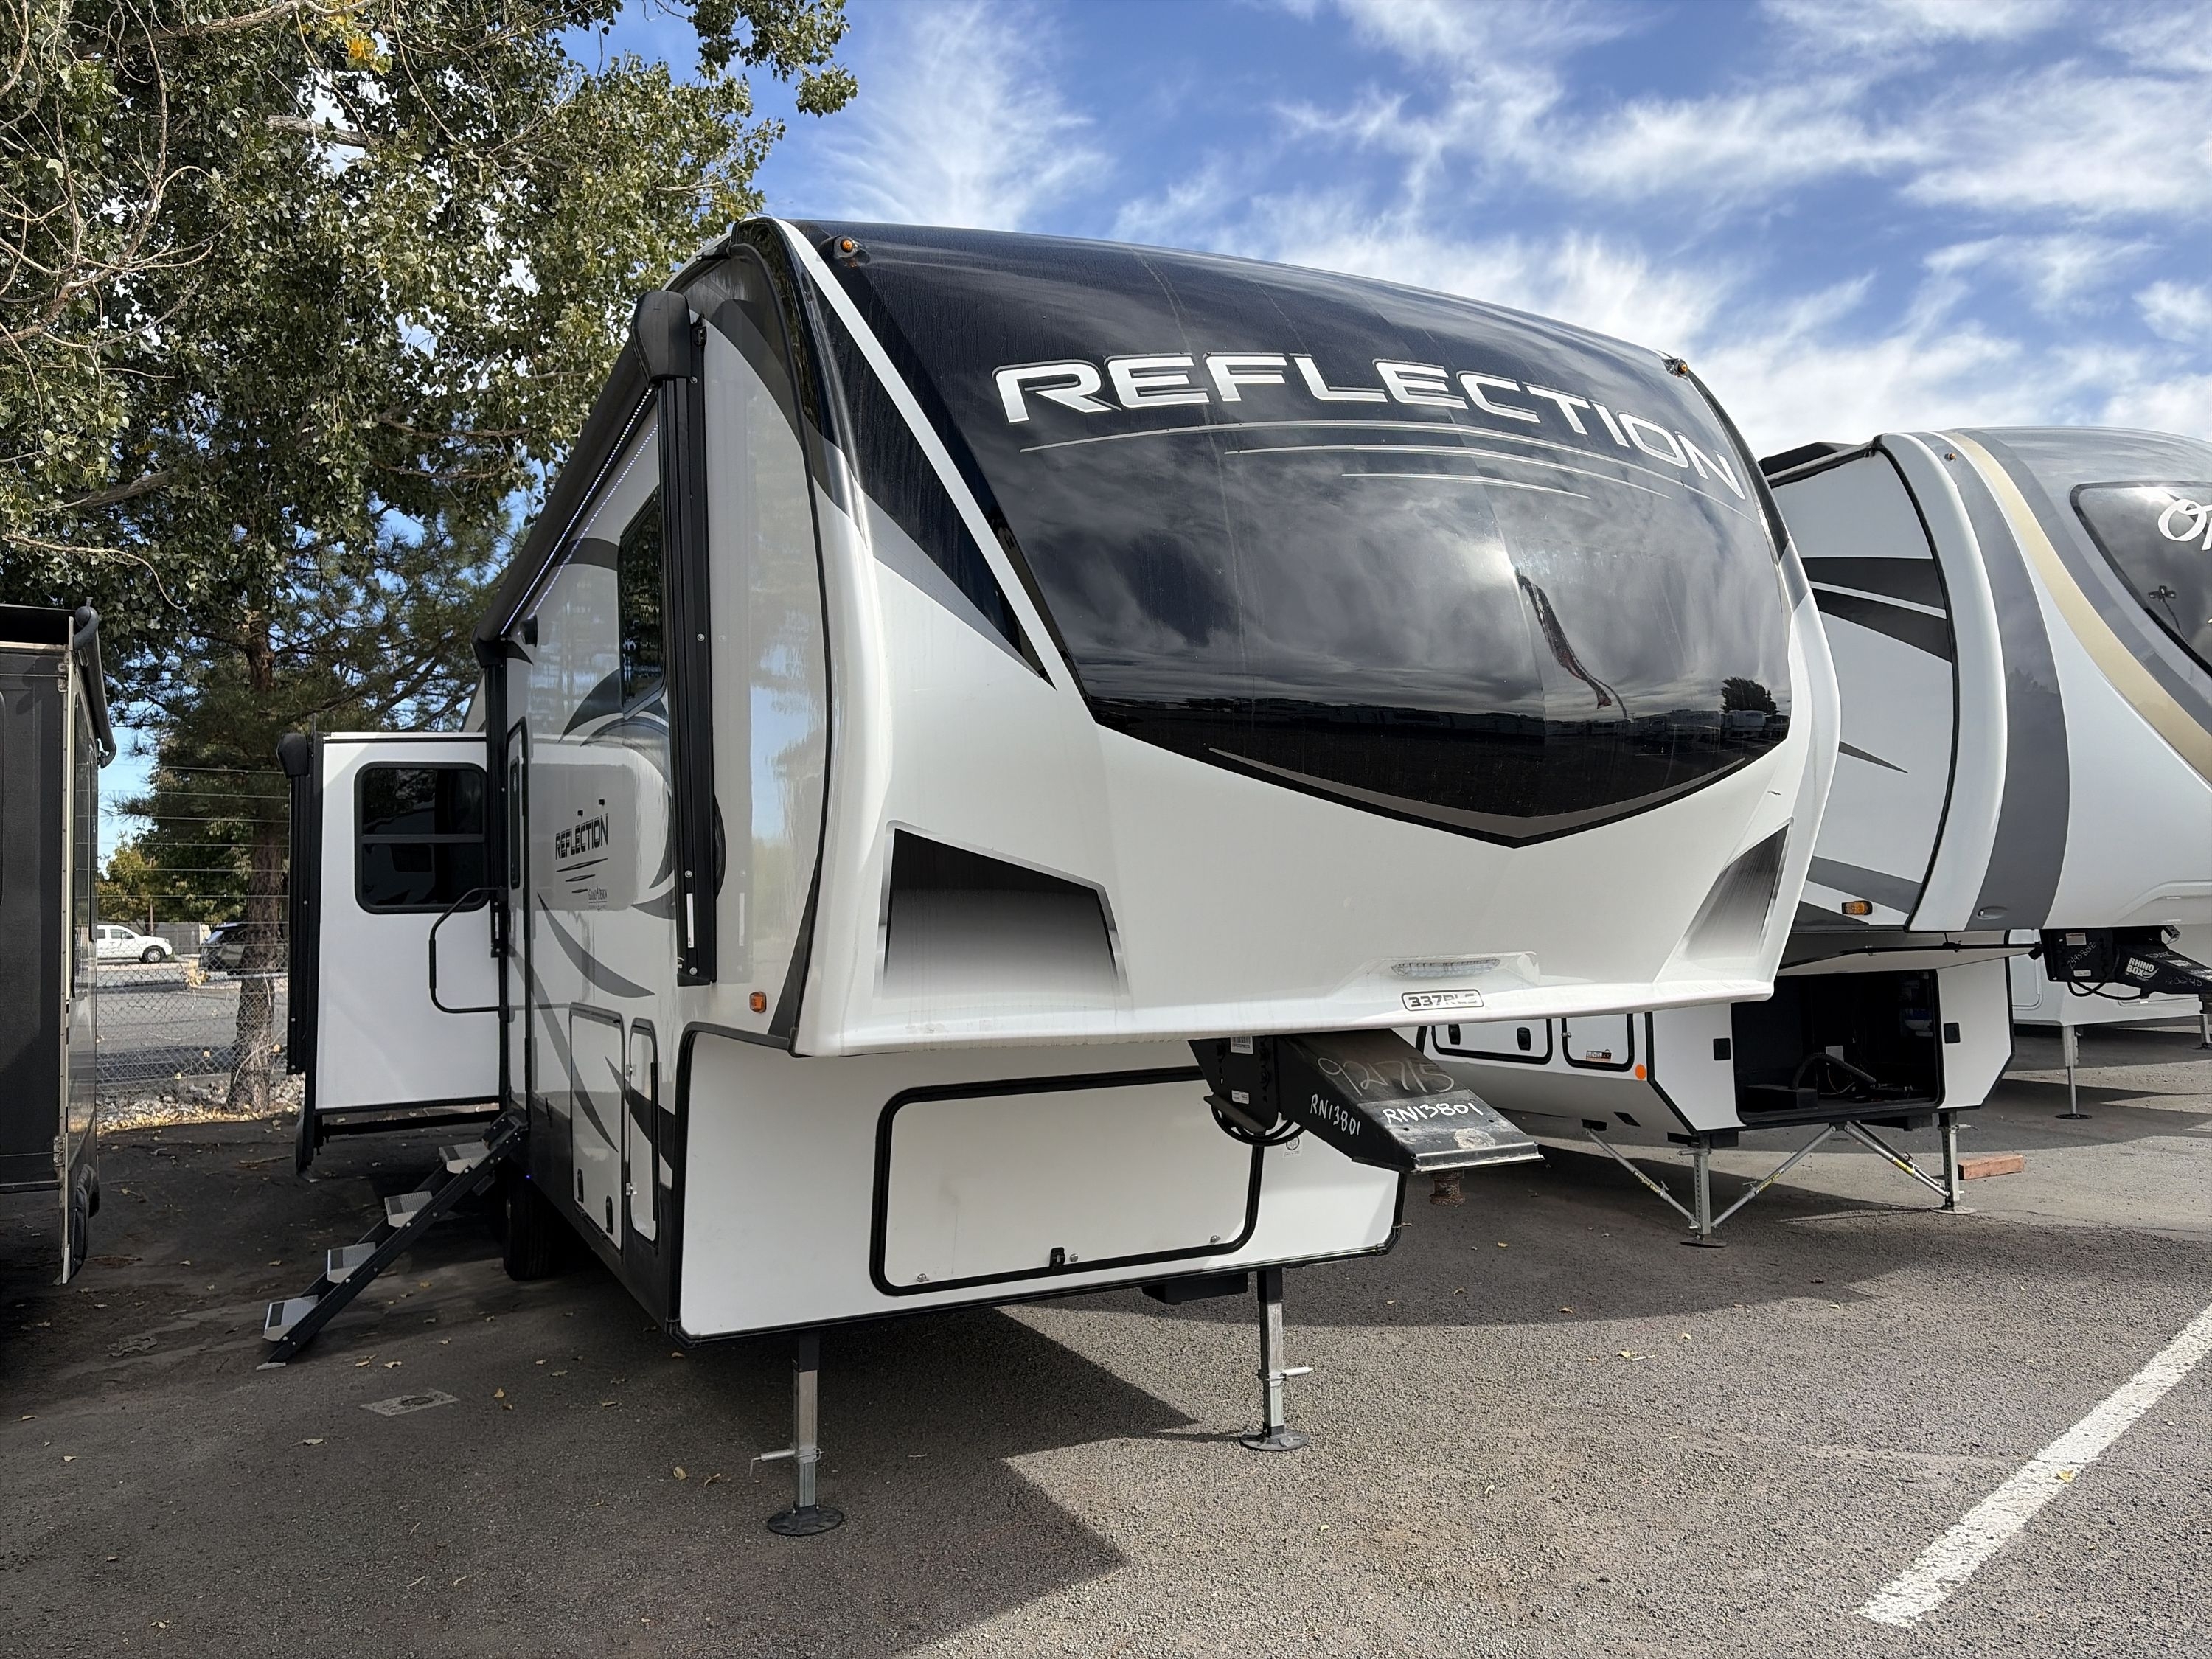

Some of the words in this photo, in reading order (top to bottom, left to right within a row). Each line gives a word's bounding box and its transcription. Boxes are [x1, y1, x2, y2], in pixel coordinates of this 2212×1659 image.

[992, 352, 1746, 500] REFLECTION
[555, 813, 608, 860] REFLECTION
[2126, 964, 2144, 977] BOX
[2128, 957, 2154, 973] RHINO
[1310, 1093, 1361, 1136] RN13801
[1382, 1102, 1484, 1124] RN13801
